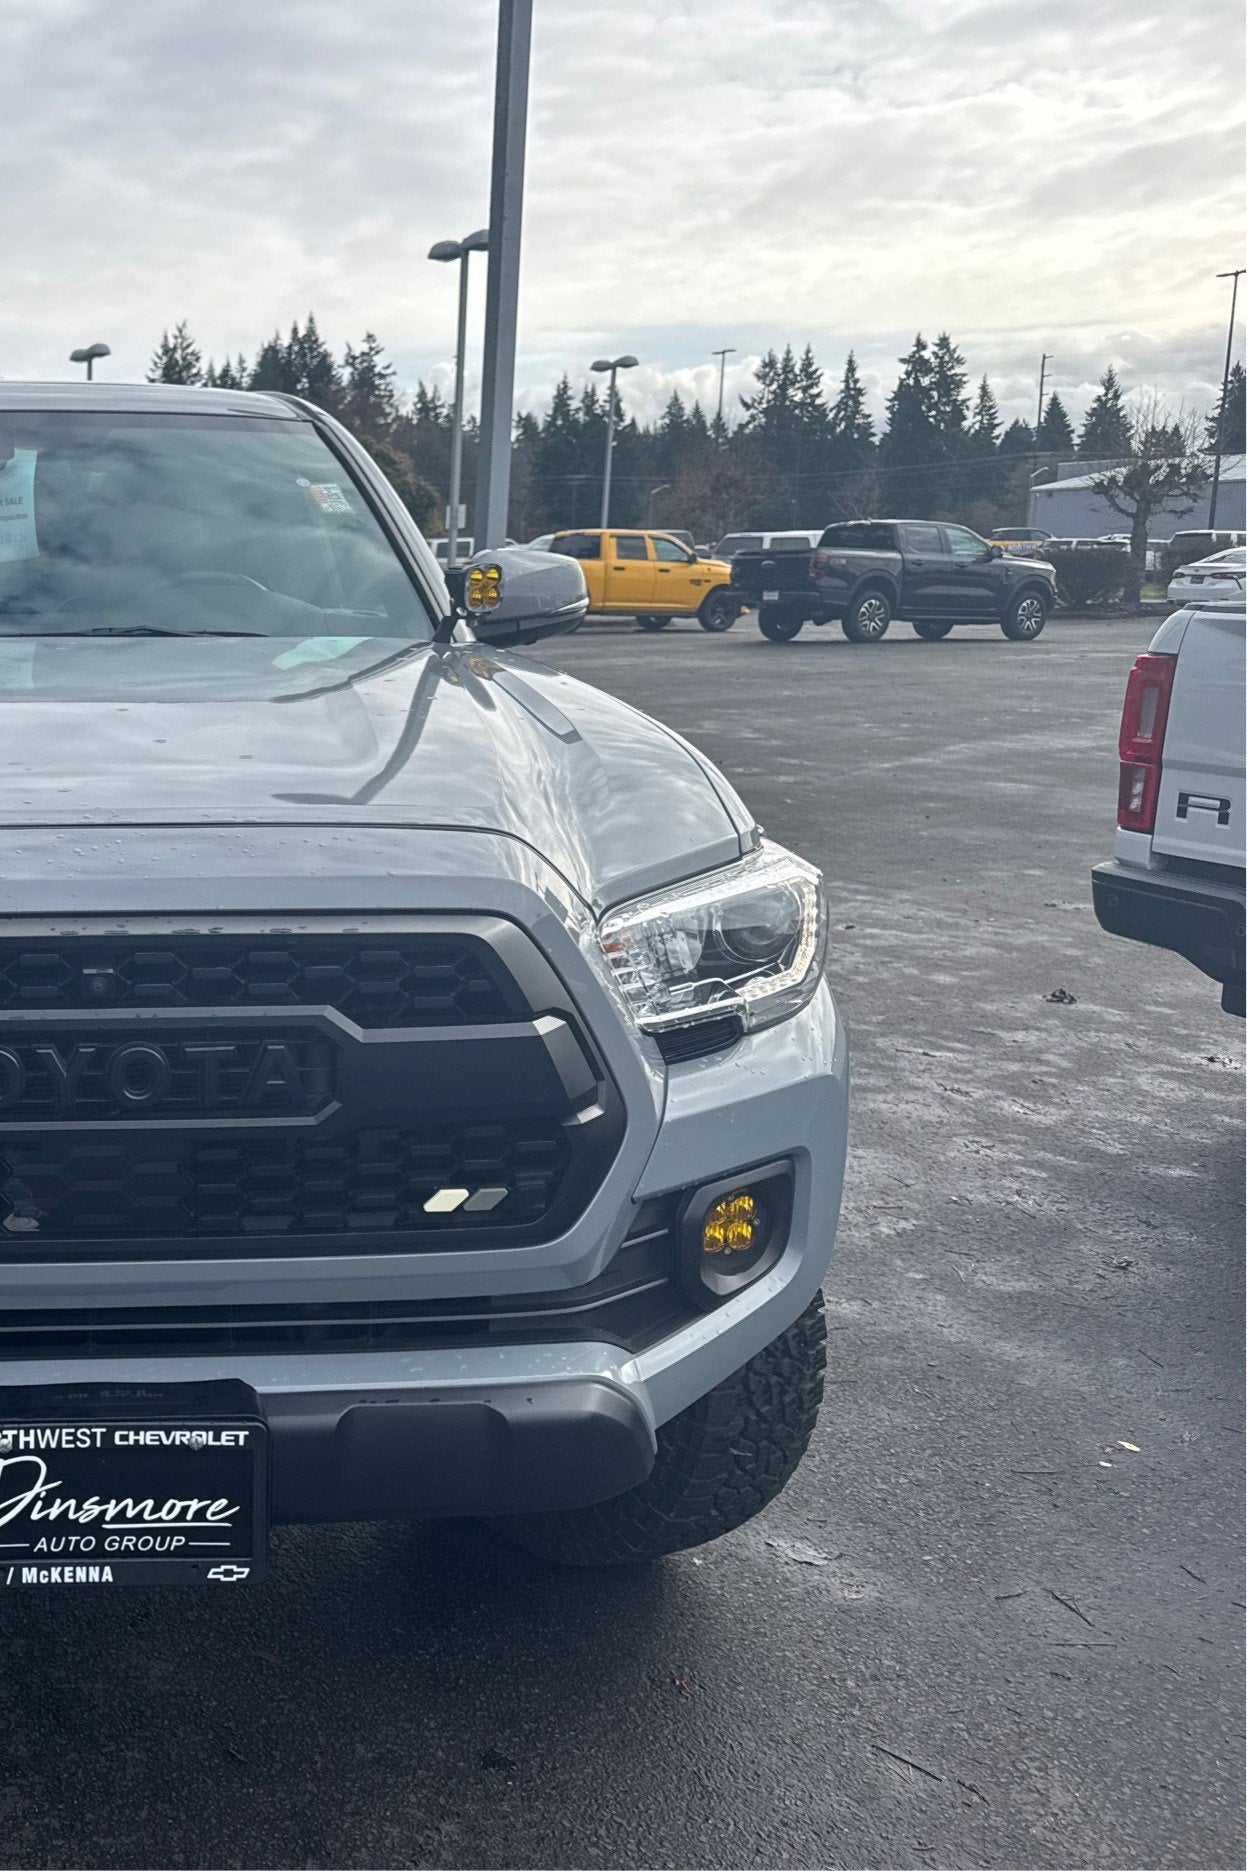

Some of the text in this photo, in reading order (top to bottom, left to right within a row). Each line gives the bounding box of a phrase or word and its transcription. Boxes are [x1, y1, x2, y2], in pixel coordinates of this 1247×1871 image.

[4, 496, 23, 506] SALE
[114, 1430, 249, 1446] CHEVROLET
[33, 1535, 186, 1552] AUTO GROUP
[22, 1566, 114, 1584] McKENNA
